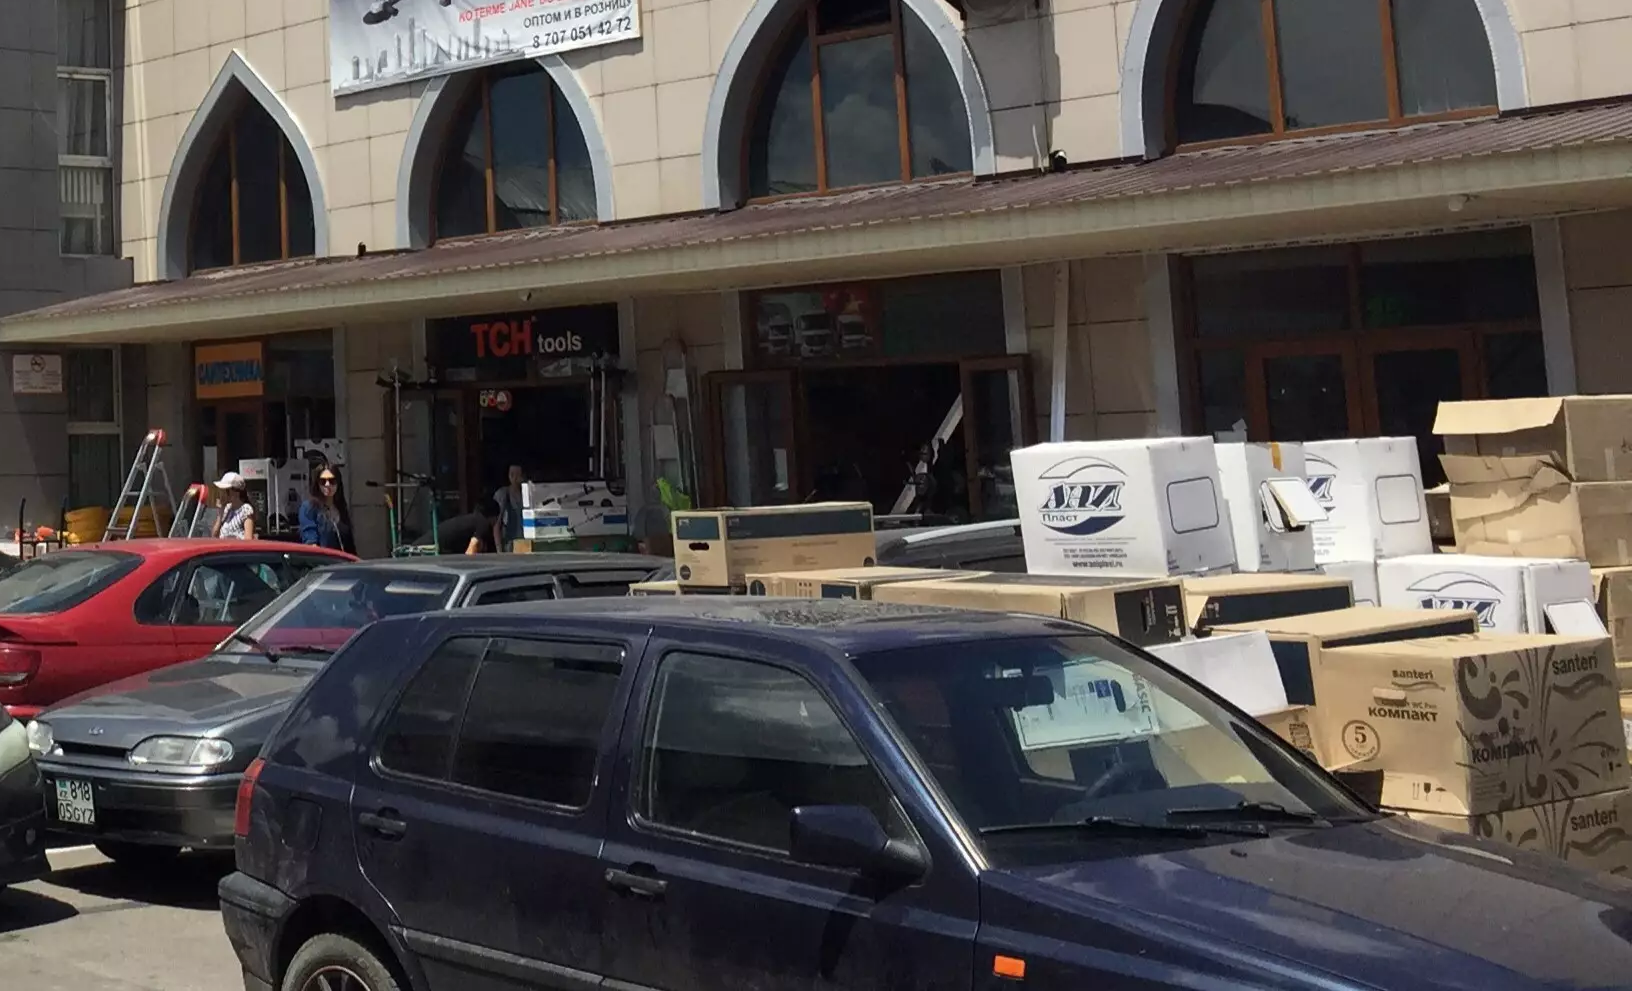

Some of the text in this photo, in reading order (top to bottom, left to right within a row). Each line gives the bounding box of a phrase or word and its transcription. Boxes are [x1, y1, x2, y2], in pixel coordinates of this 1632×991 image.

[523, 11, 562, 29] ОПТОМ
[563, 8, 572, 20] И
[574, 6, 582, 18] В
[532, 16, 632, 48] 8 707 051 42 72
[470, 320, 582, 358] TCH tools
[1042, 513, 1079, 523] Пласт
[1391, 669, 1434, 680] santeri
[1551, 650, 1599, 676] santeri
[1354, 725, 1367, 744] 5
[70, 780, 91, 801] 818
[1570, 801, 1618, 832] santeri
